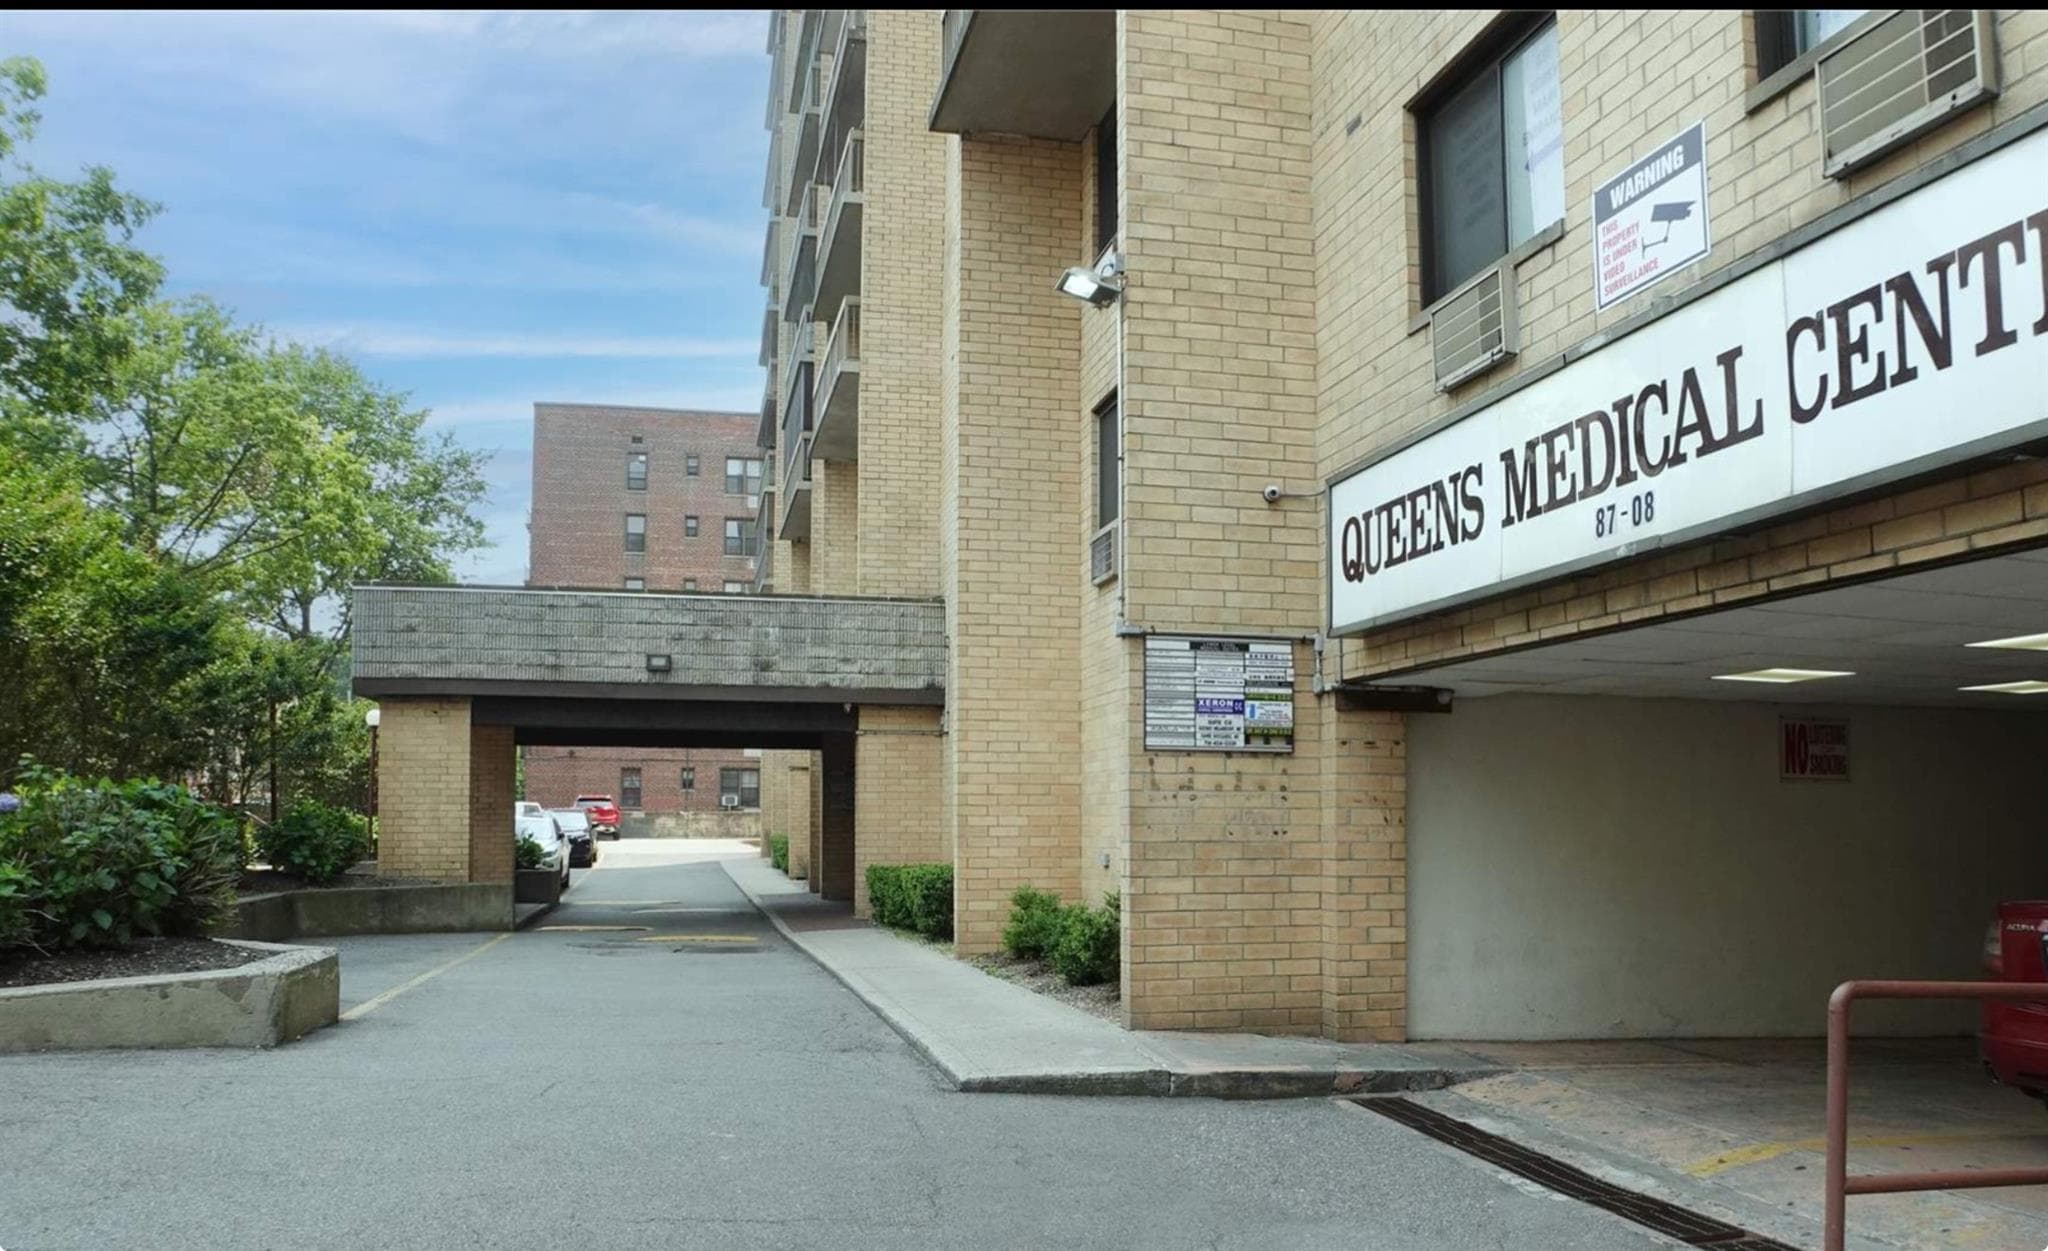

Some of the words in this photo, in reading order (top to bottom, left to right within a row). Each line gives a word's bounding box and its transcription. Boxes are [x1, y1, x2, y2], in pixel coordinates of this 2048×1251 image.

[1610, 145, 1684, 210] WARNING
[1602, 220, 1619, 236] THIS
[1602, 221, 1641, 252] PROPERTY
[1603, 255, 1610, 266] IS
[1612, 238, 1638, 264] UNDER
[1603, 261, 1625, 282] VIDEO
[1604, 256, 1660, 297] SURVEILLANCE
[1342, 463, 1484, 583] QUEENS
[1500, 345, 1764, 528] MEDICAL
[1595, 491, 1655, 538] 87-08
[1199, 699, 1234, 708] XERON
[1784, 723, 1809, 775] NO
